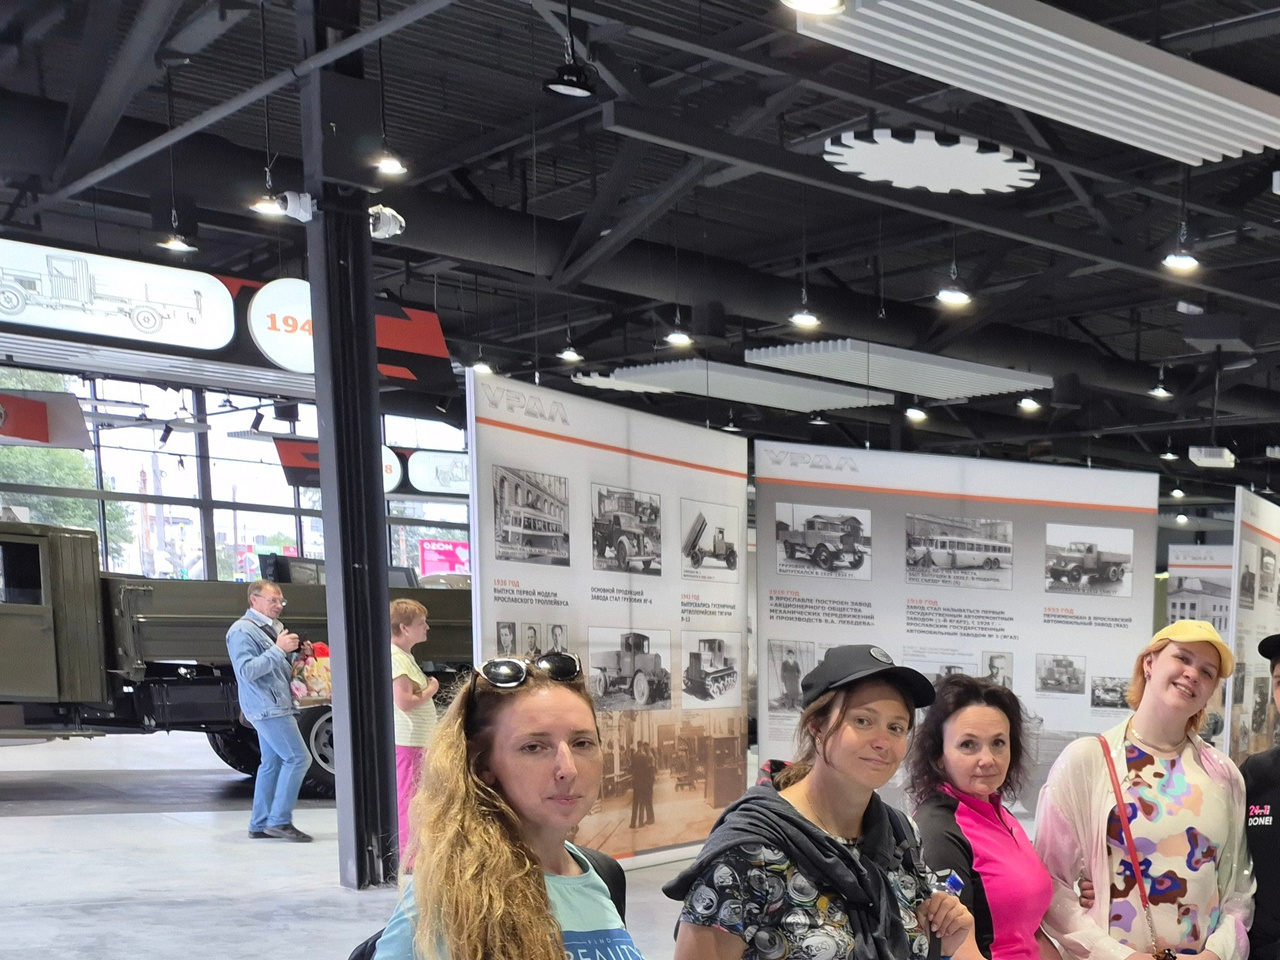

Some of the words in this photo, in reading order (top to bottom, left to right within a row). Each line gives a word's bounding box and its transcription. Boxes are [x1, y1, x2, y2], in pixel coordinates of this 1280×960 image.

[266, 313, 313, 336] 194
[481, 383, 569, 426] УРАЛ
[764, 449, 859, 472] УРАЛ
[423, 542, 453, 550] OZON
[516, 588, 536, 596] ПЕРВОЙ
[776, 616, 822, 624] ПРОИЗВОДСТВ
[822, 612, 874, 620] ПЕРЕДВИЖЕНИЙ
[1248, 816, 1273, 826] DONE!
